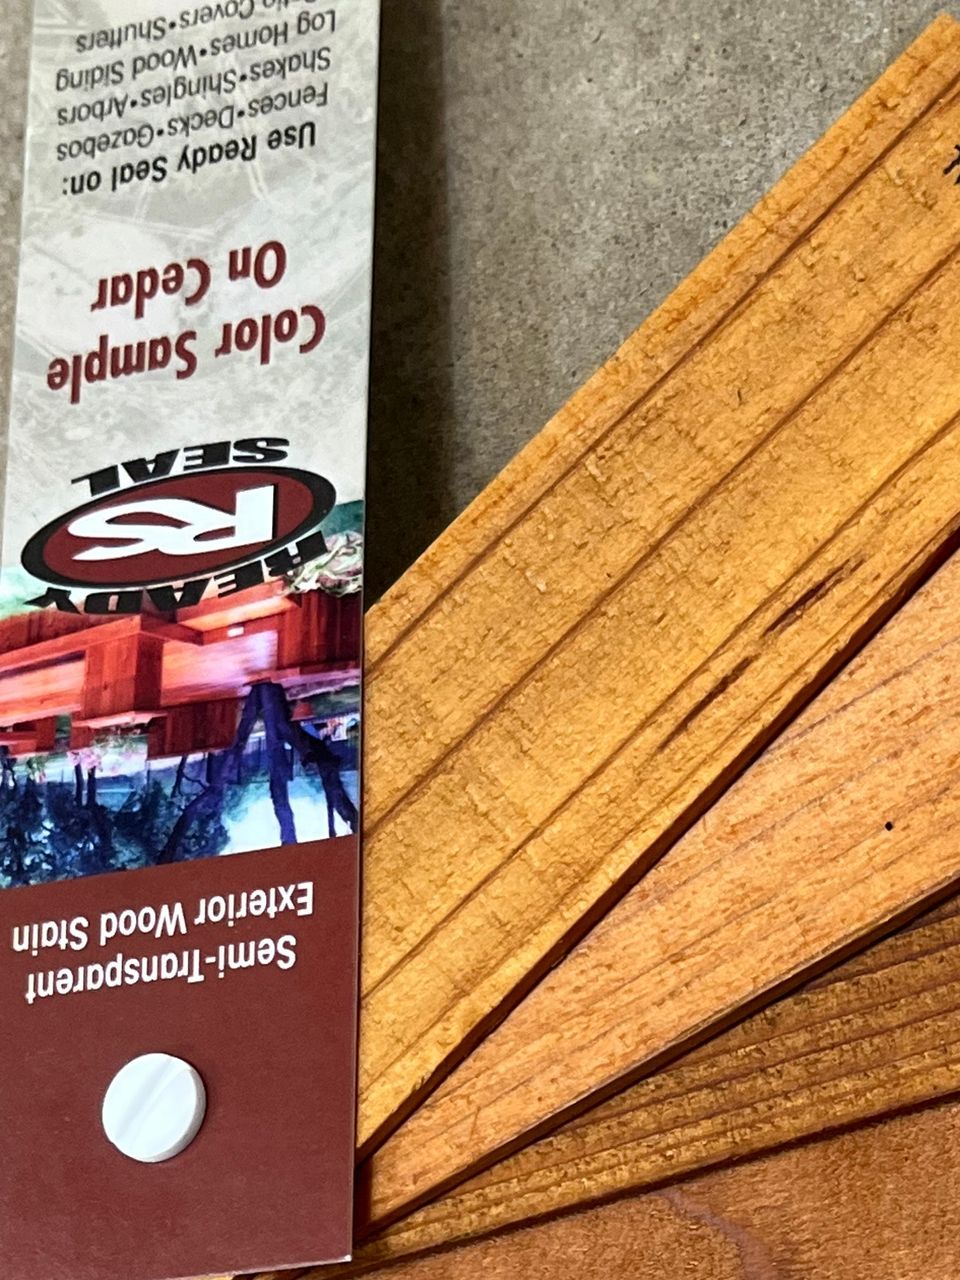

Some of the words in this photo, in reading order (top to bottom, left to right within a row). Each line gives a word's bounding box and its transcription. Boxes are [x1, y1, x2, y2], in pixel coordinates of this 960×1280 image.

[298, 10, 336, 35] Log
[56, 61, 125, 92] Siding
[177, 135, 257, 174] Ready
[267, 122, 316, 150] Use
[62, 170, 102, 196] on:
[111, 155, 168, 192] Seal
[228, 240, 287, 289] On
[91, 258, 211, 319] Cedar
[214, 304, 326, 365] Color
[47, 330, 197, 404] Sample
[71, 437, 290, 497] SEAL
[67, 484, 278, 561] RS
[24, 529, 328, 616] READY
[99, 901, 188, 947] Wood
[193, 881, 315, 928] Exterior
[11, 915, 90, 956] Stain
[24, 934, 297, 1005] Semi-Transparent
